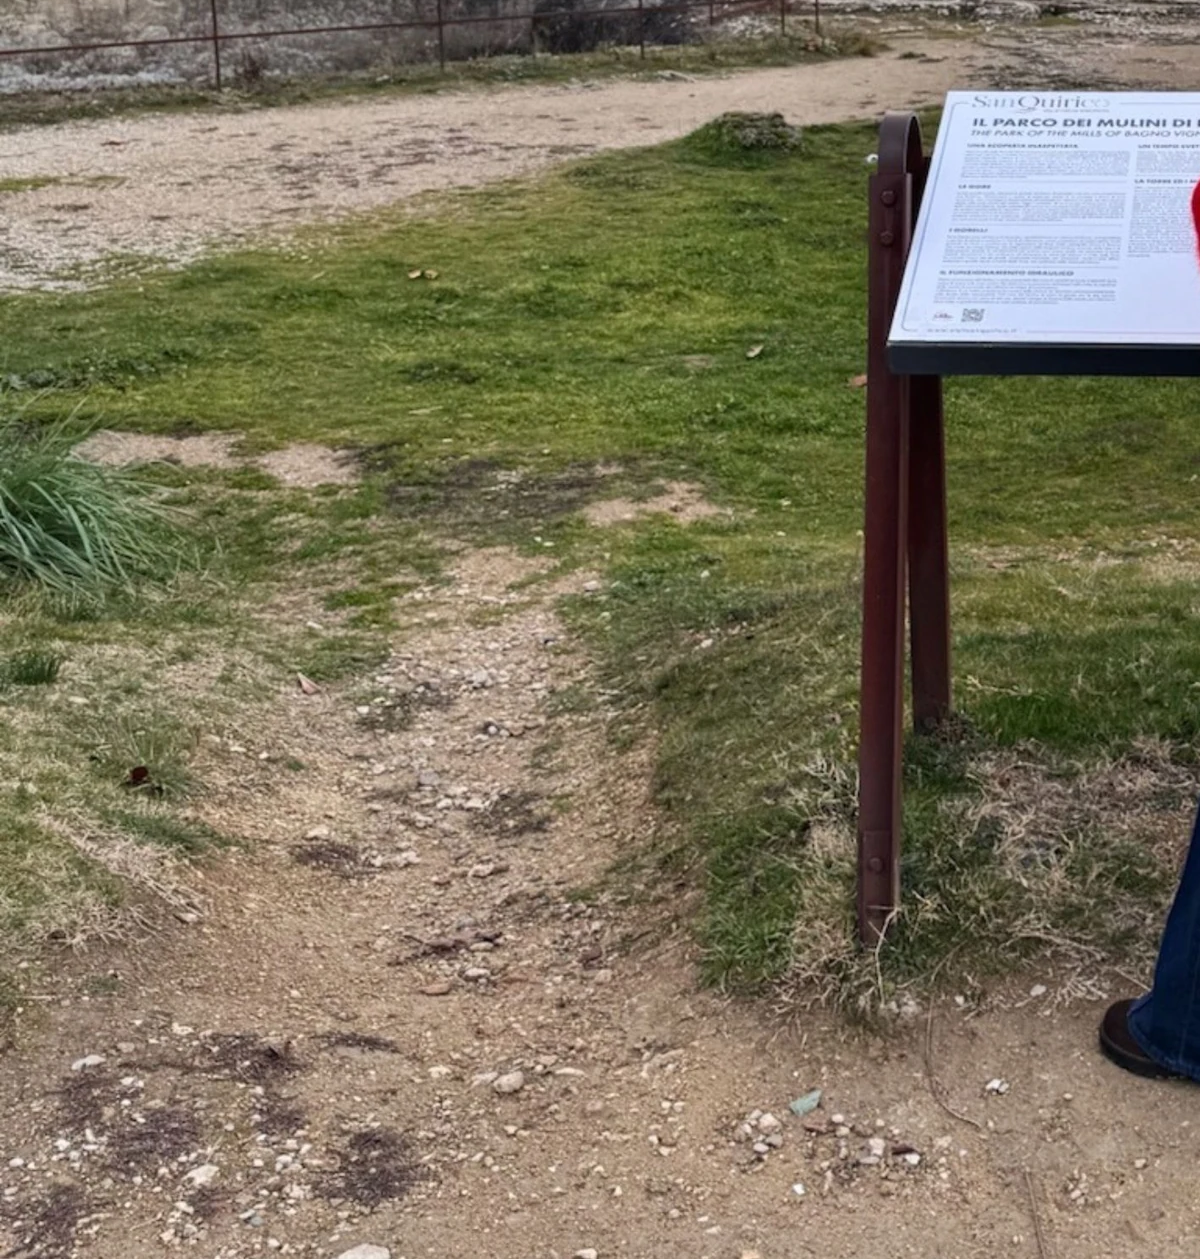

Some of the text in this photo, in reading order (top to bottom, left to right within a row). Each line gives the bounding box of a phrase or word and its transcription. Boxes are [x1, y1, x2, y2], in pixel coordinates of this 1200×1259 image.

[972, 118, 988, 127] IL
[992, 118, 1058, 128] PARCO
[1062, 118, 1092, 128] DEI
[1096, 118, 1167, 128] MULINI
[1172, 118, 1192, 128] DI
[1026, 129, 1044, 137] OF
[1046, 129, 1068, 137] THE
[1069, 129, 1103, 137] MILLS
[1104, 129, 1122, 137] OF
[1123, 129, 1171, 138] BAGNO
